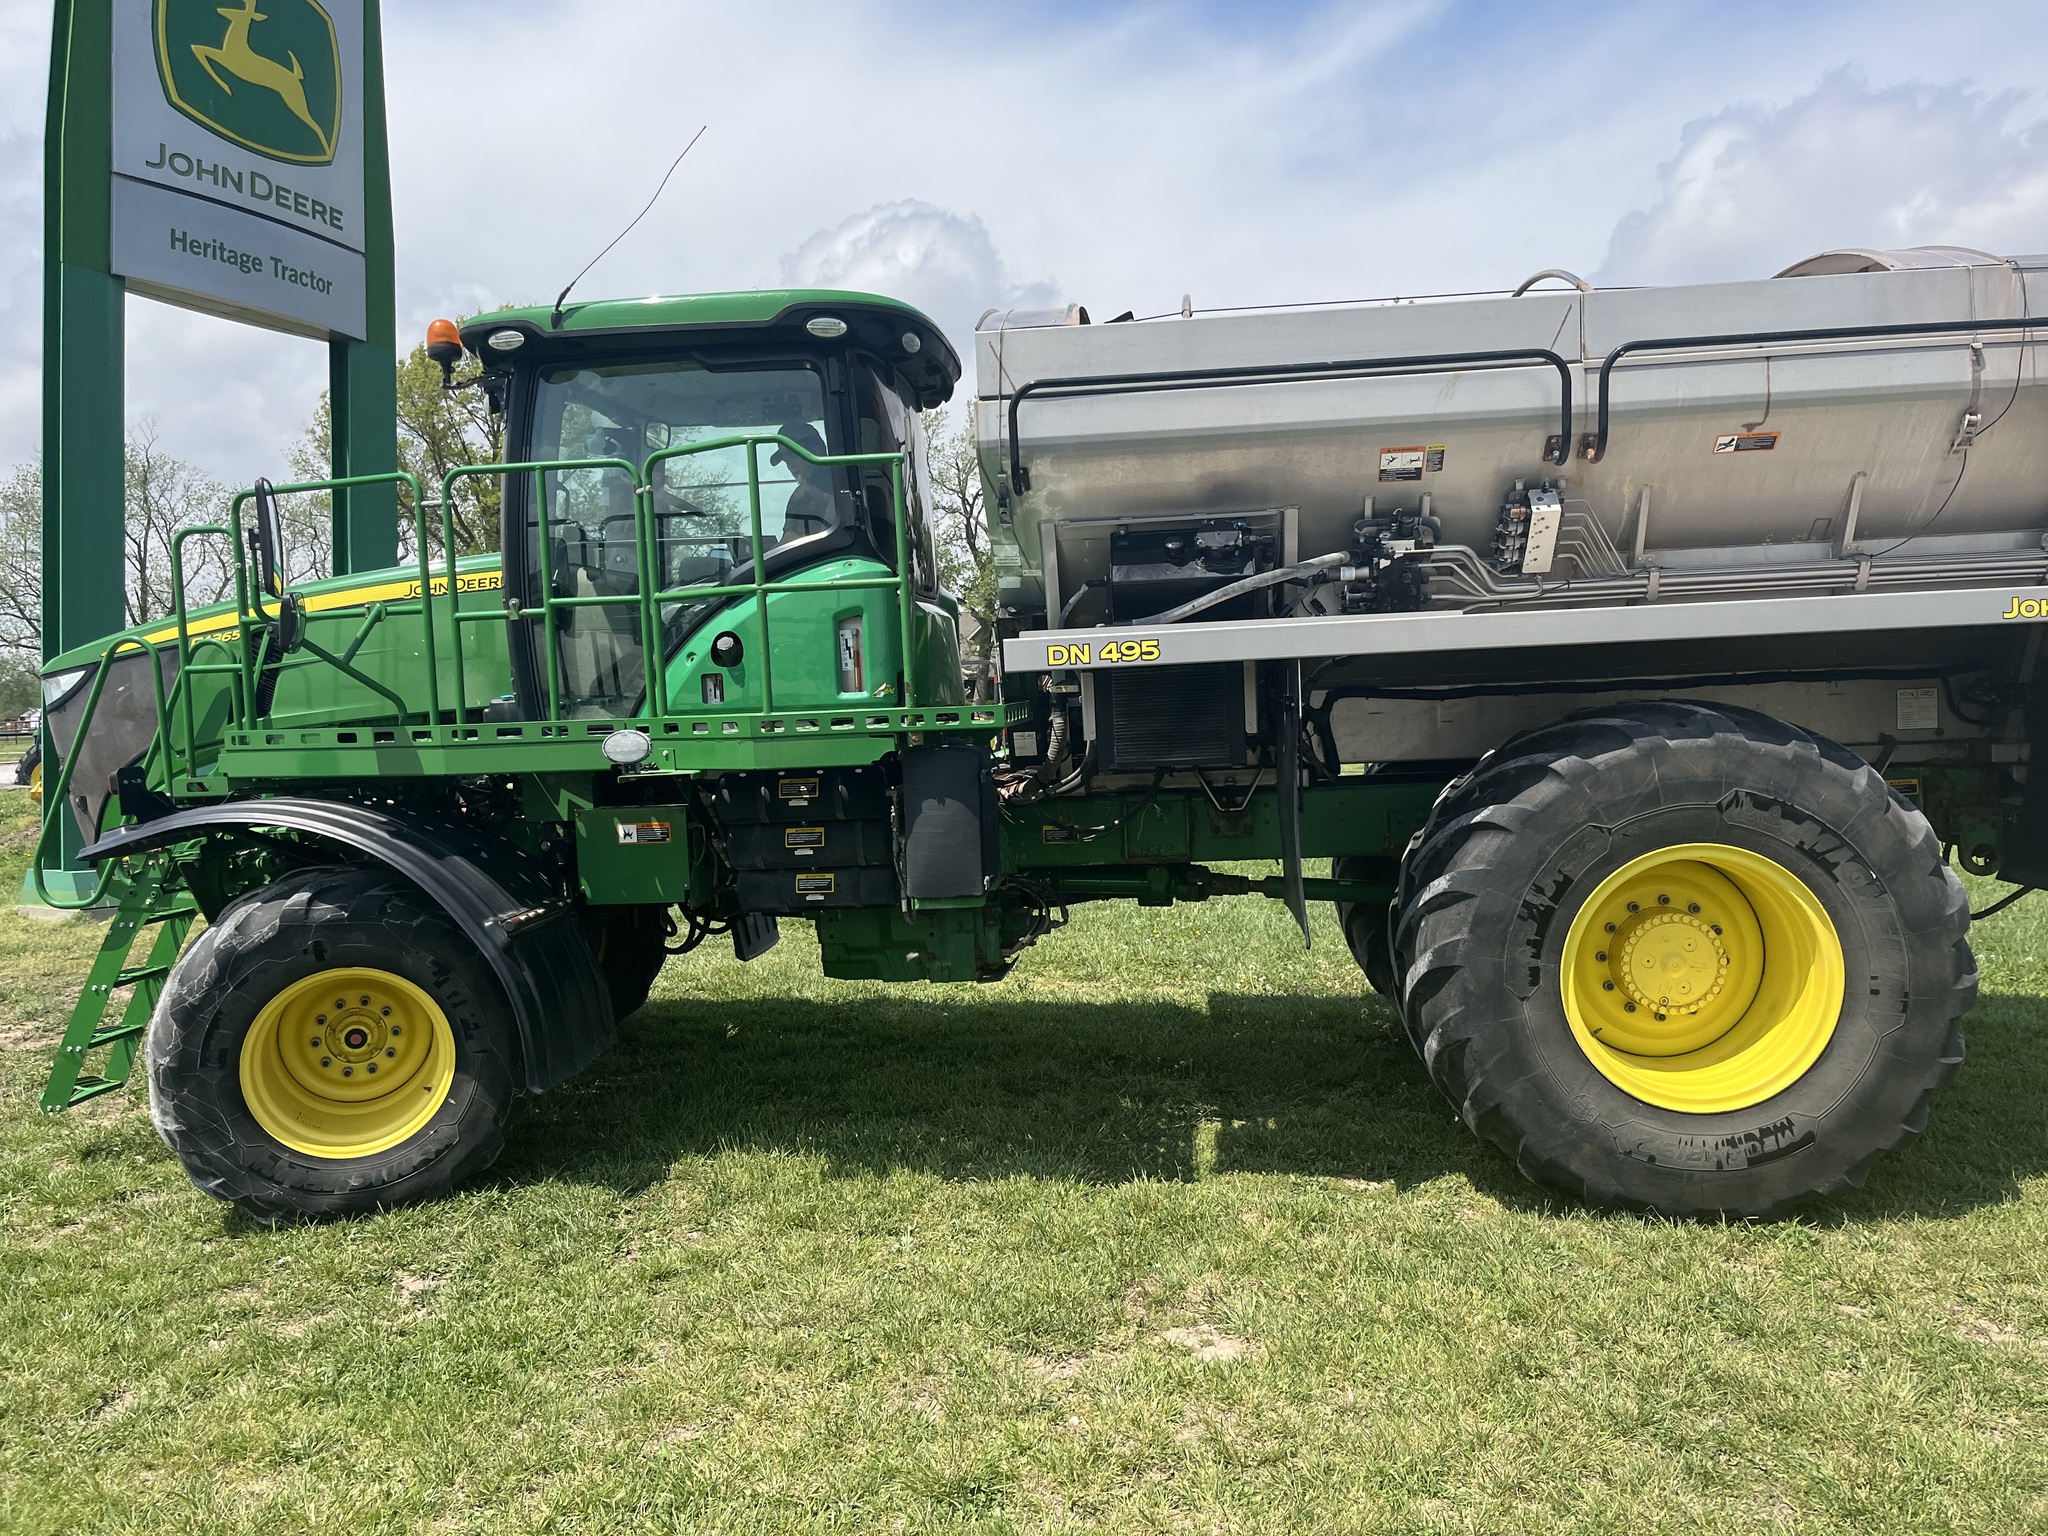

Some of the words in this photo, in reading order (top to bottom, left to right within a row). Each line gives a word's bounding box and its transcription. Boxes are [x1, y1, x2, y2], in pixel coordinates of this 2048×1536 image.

[145, 143, 243, 194] JOHN
[250, 171, 344, 232] DEERE
[170, 228, 263, 274] Heritage
[270, 256, 333, 295] Tractor
[456, 577, 503, 591] DEER
[1047, 643, 1091, 666] DN
[1099, 639, 1160, 663] 495
